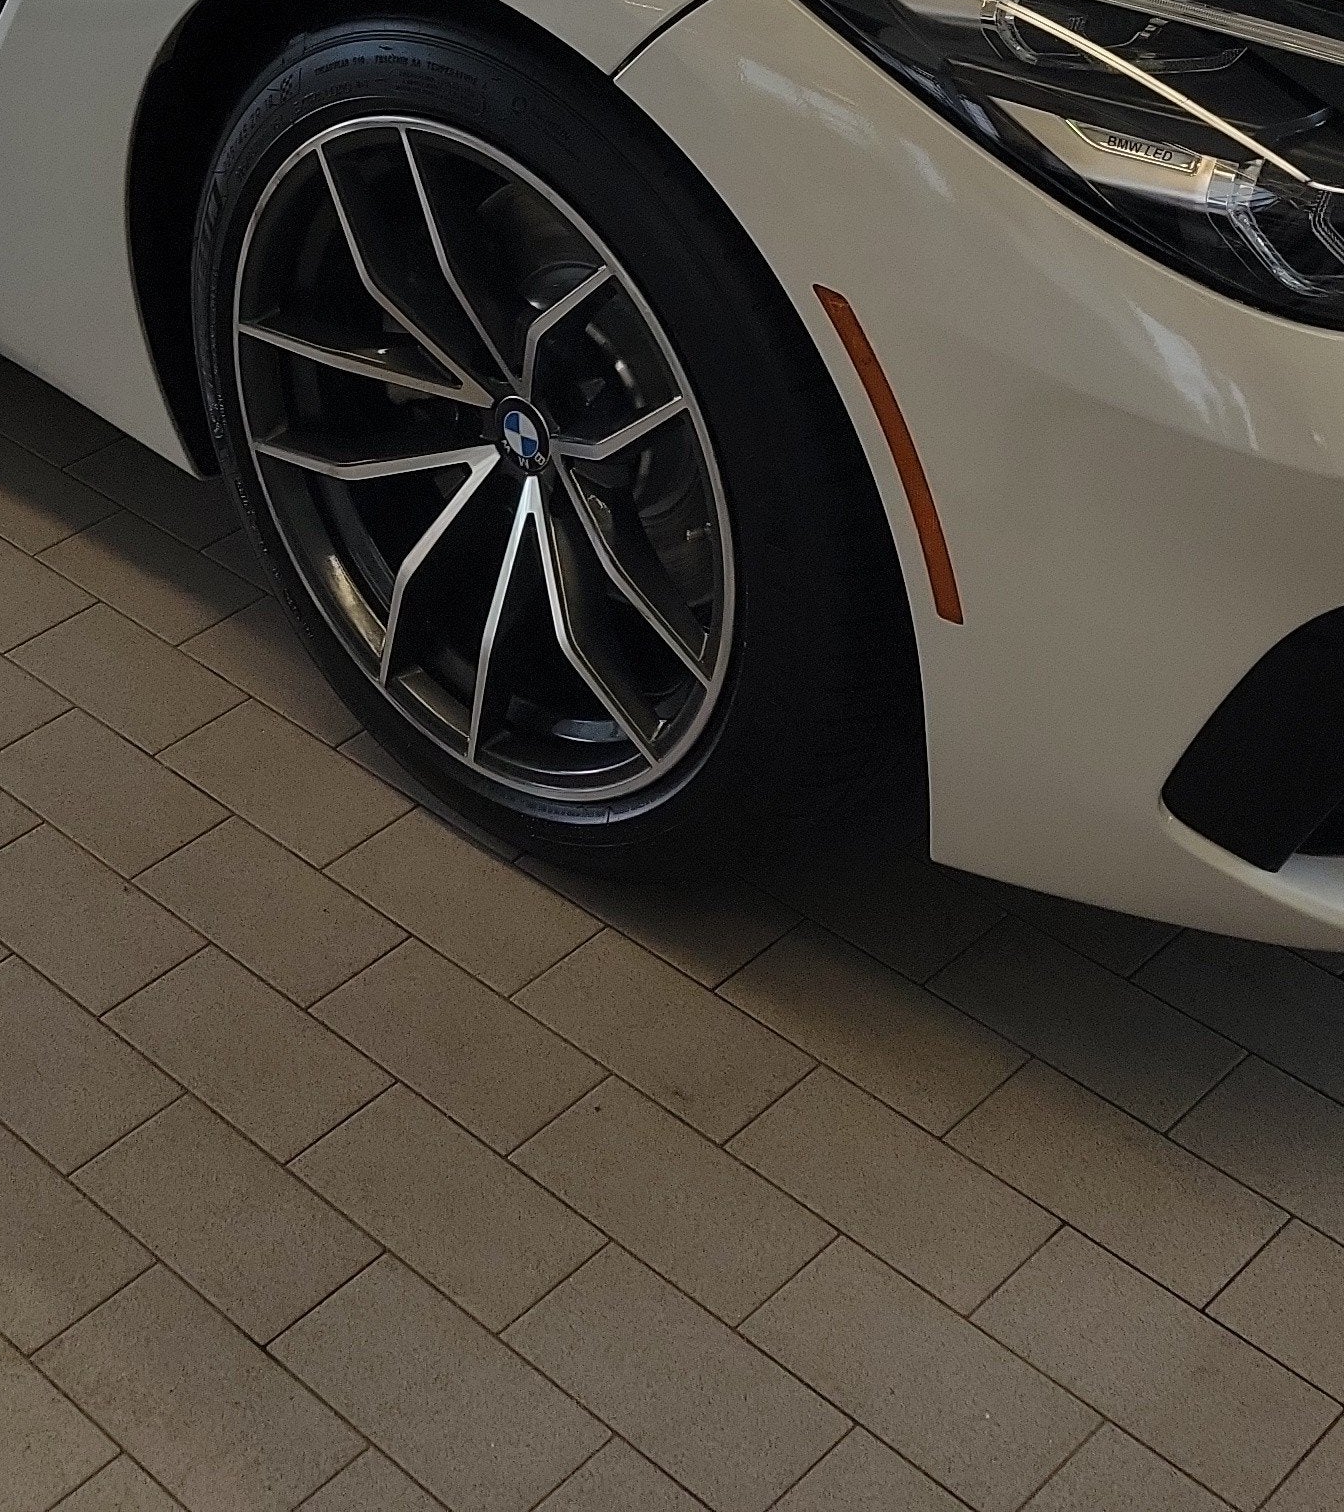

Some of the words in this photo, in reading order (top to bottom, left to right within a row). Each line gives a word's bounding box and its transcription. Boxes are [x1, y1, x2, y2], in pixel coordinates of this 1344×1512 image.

[1107, 135, 1143, 154] BMW
[1144, 145, 1173, 162] LED
[500, 439, 547, 470] BMW
